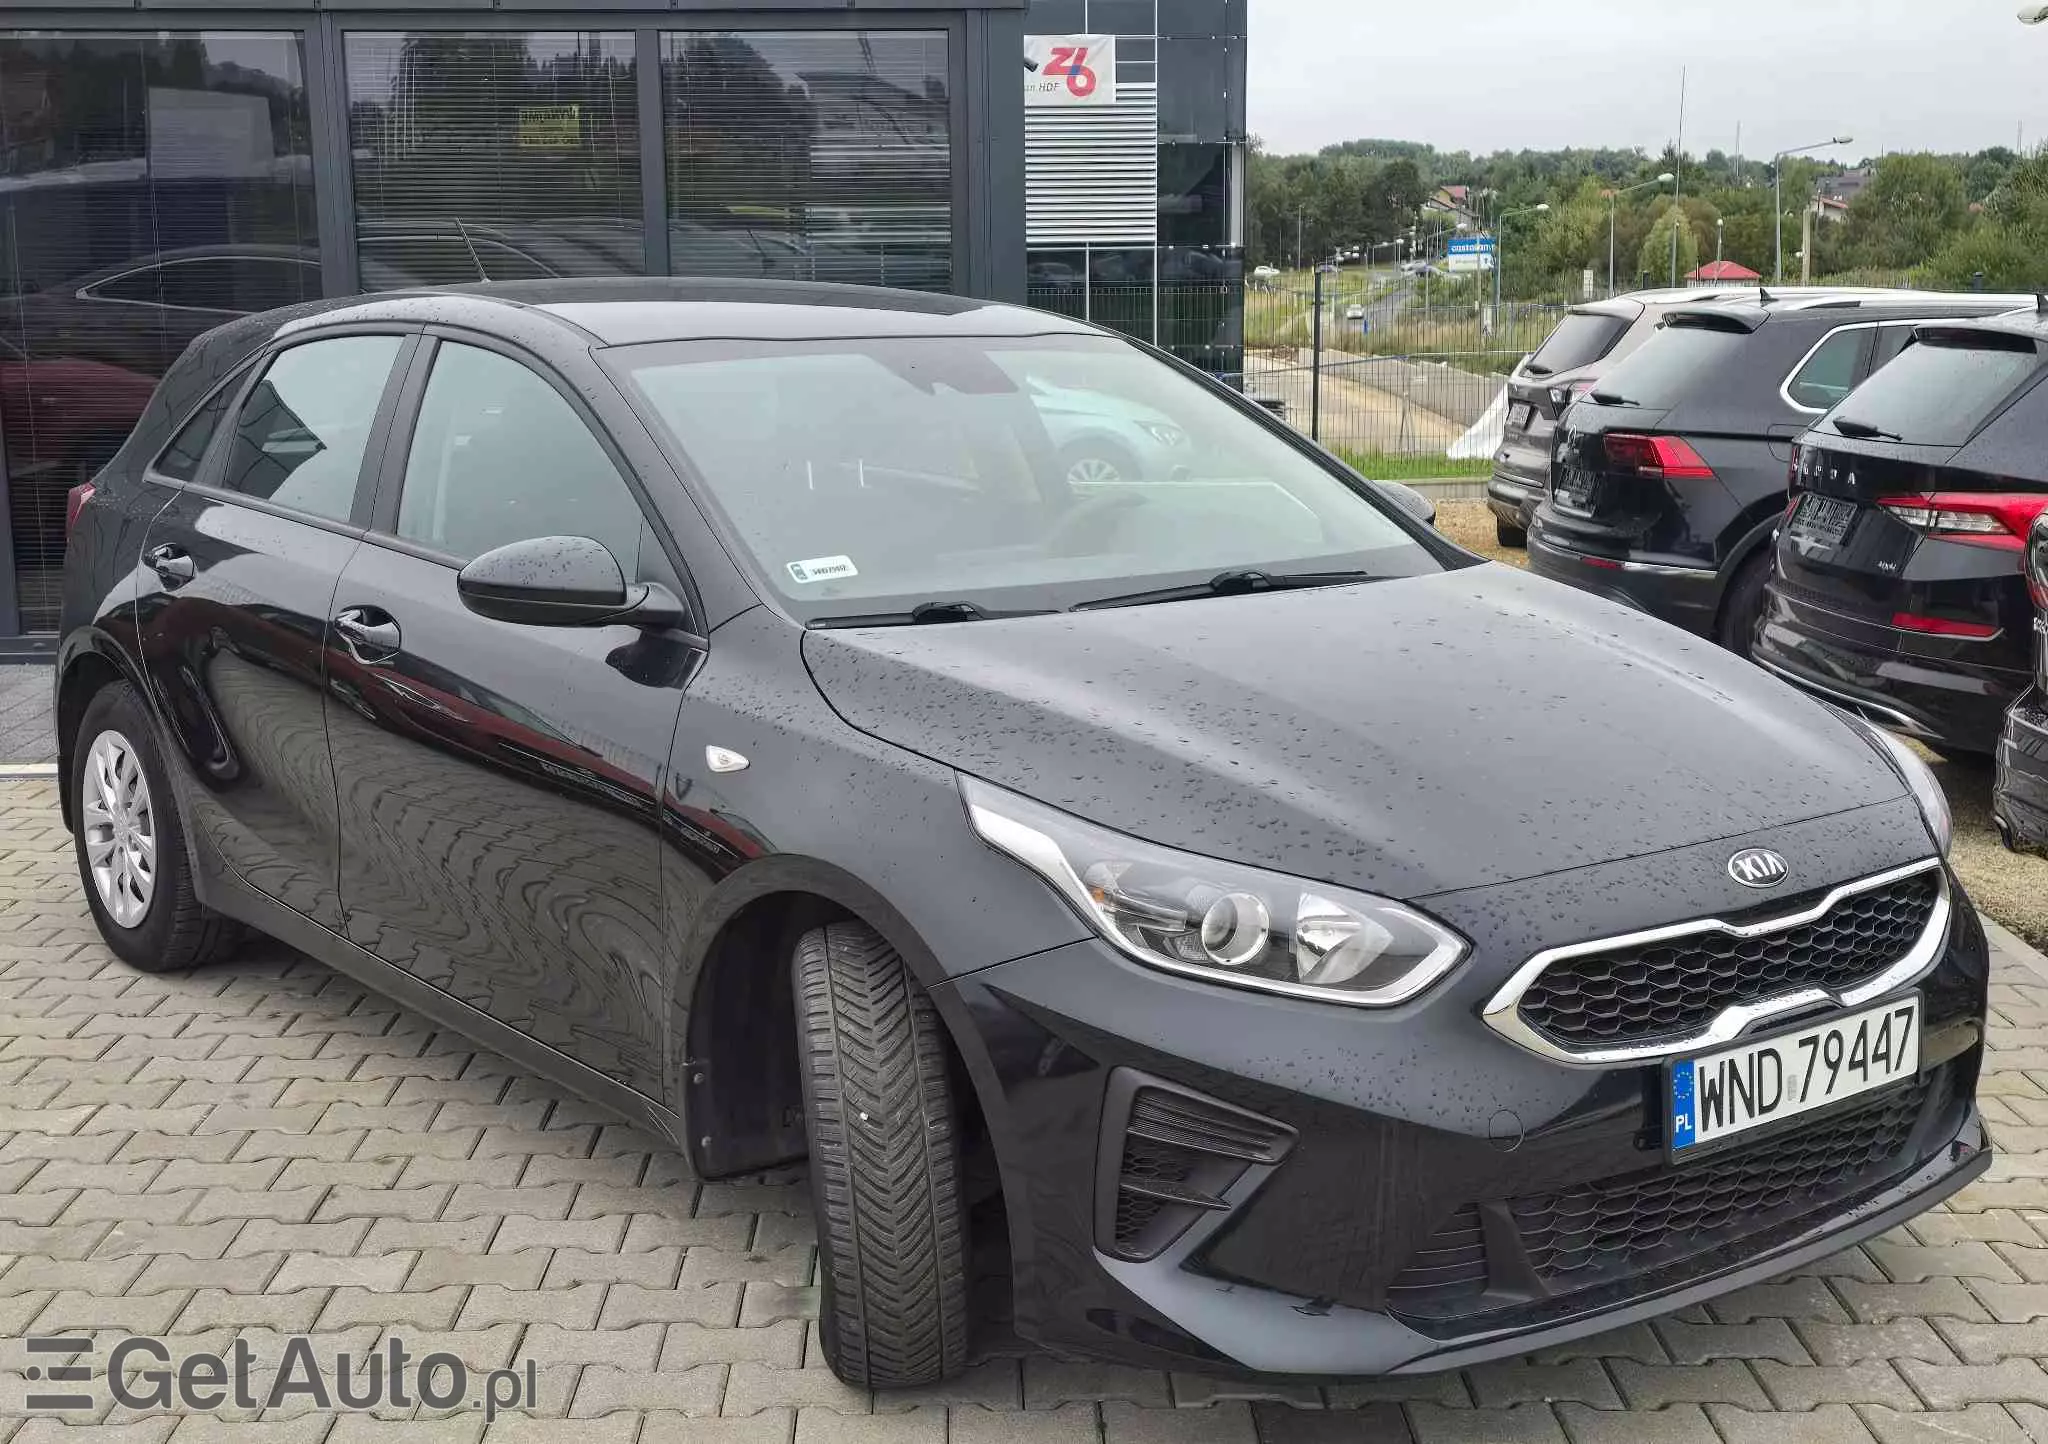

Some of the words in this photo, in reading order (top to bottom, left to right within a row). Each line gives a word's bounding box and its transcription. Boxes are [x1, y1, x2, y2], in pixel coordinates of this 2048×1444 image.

[1735, 853, 1785, 881] KIA
[1700, 1047, 1783, 1132] WND
[1798, 1005, 1915, 1104] 79447
[1675, 1114, 1692, 1133] PL
